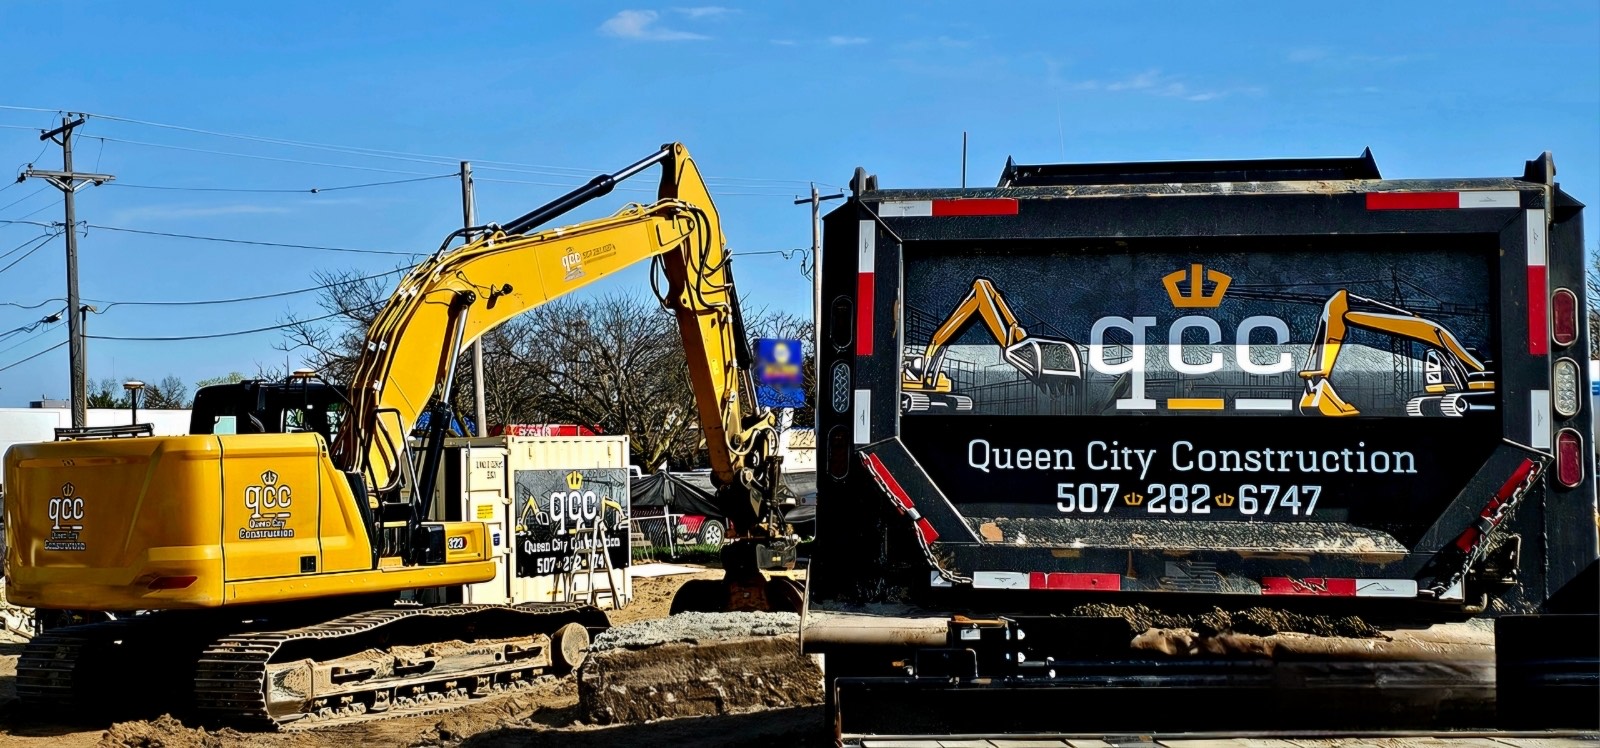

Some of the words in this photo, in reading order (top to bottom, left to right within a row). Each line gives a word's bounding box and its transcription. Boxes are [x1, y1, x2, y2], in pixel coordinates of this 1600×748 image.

[1088, 315, 1294, 410] qcc
[967, 438, 1076, 471] Queen
[1086, 440, 1157, 480] City
[1171, 440, 1418, 474] Construction
[48, 498, 84, 530] qcc
[245, 485, 292, 519] qcc
[549, 490, 597, 536] qcc
[1056, 483, 1120, 514] 507
[1147, 483, 1211, 514] 282
[1238, 484, 1322, 515] 6747
[524, 540, 551, 555] Queen
[537, 557, 557, 574] 507
